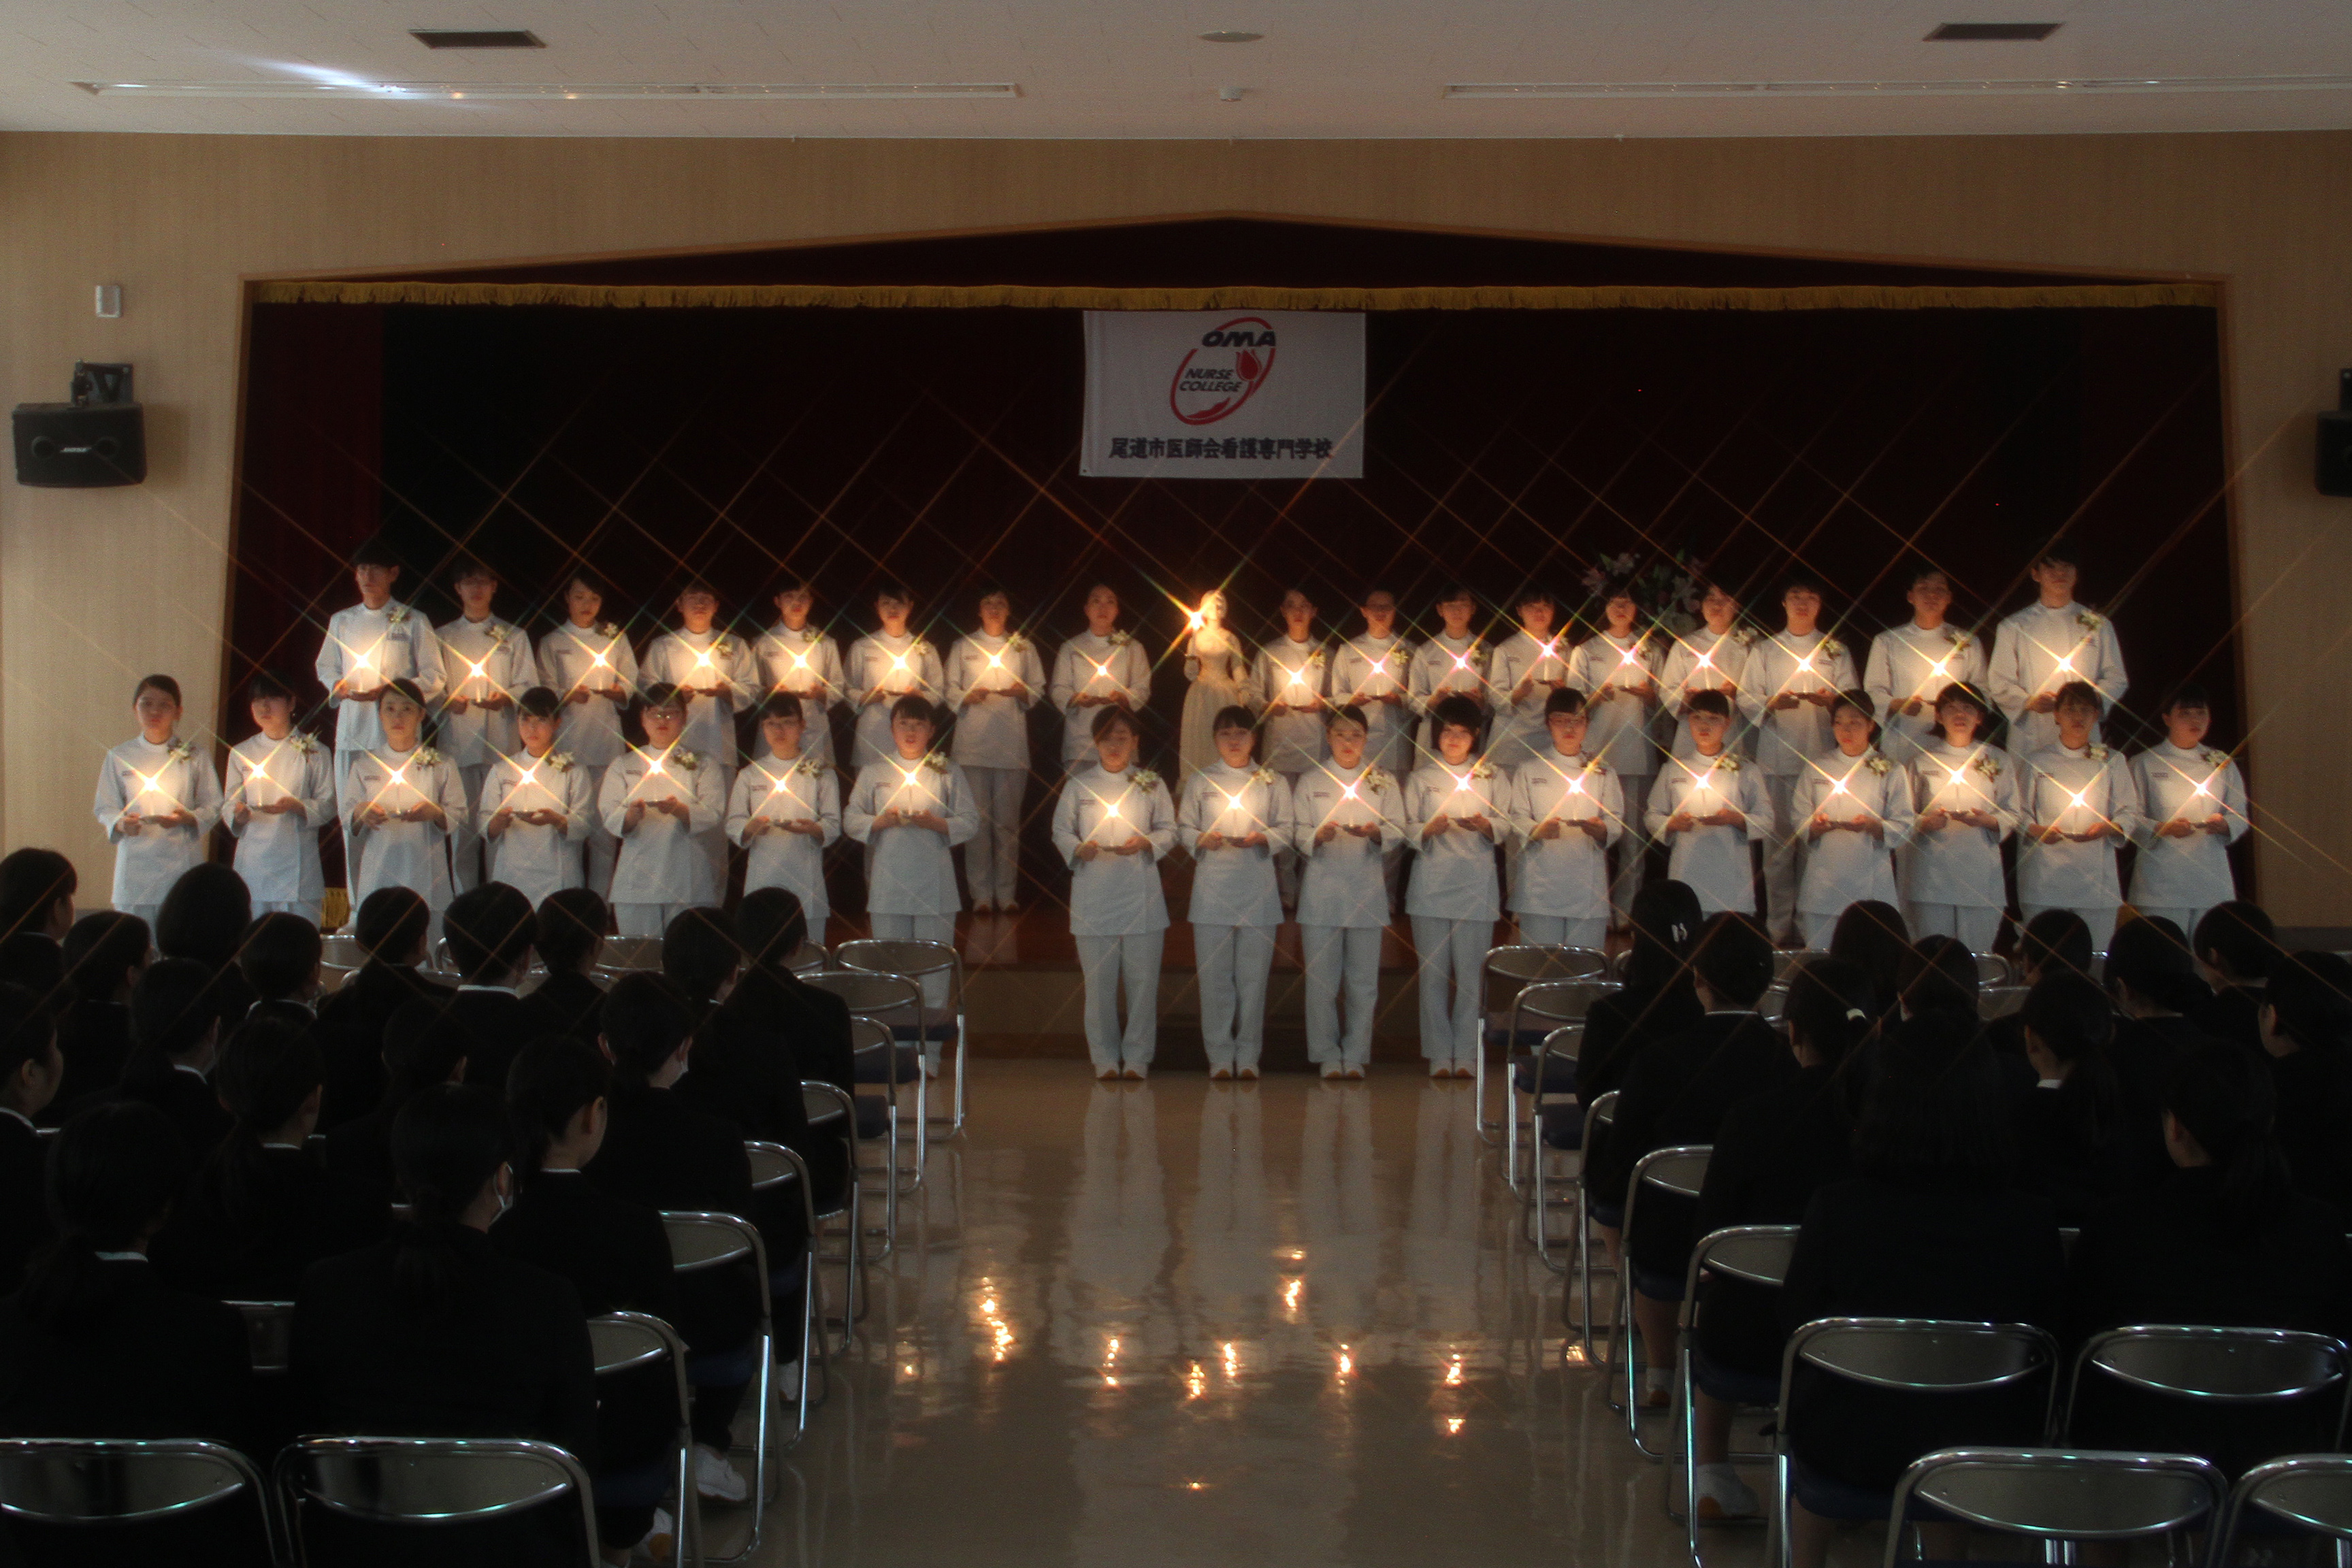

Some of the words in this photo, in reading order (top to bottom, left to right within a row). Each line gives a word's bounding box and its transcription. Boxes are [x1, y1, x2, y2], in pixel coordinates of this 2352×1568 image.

[1202, 331, 1276, 347] OMA
[1185, 368, 1234, 379] NURSE
[1179, 380, 1241, 392] COLLEGE
[1109, 438, 1333, 459] 尾道市医師会看護専門学校
